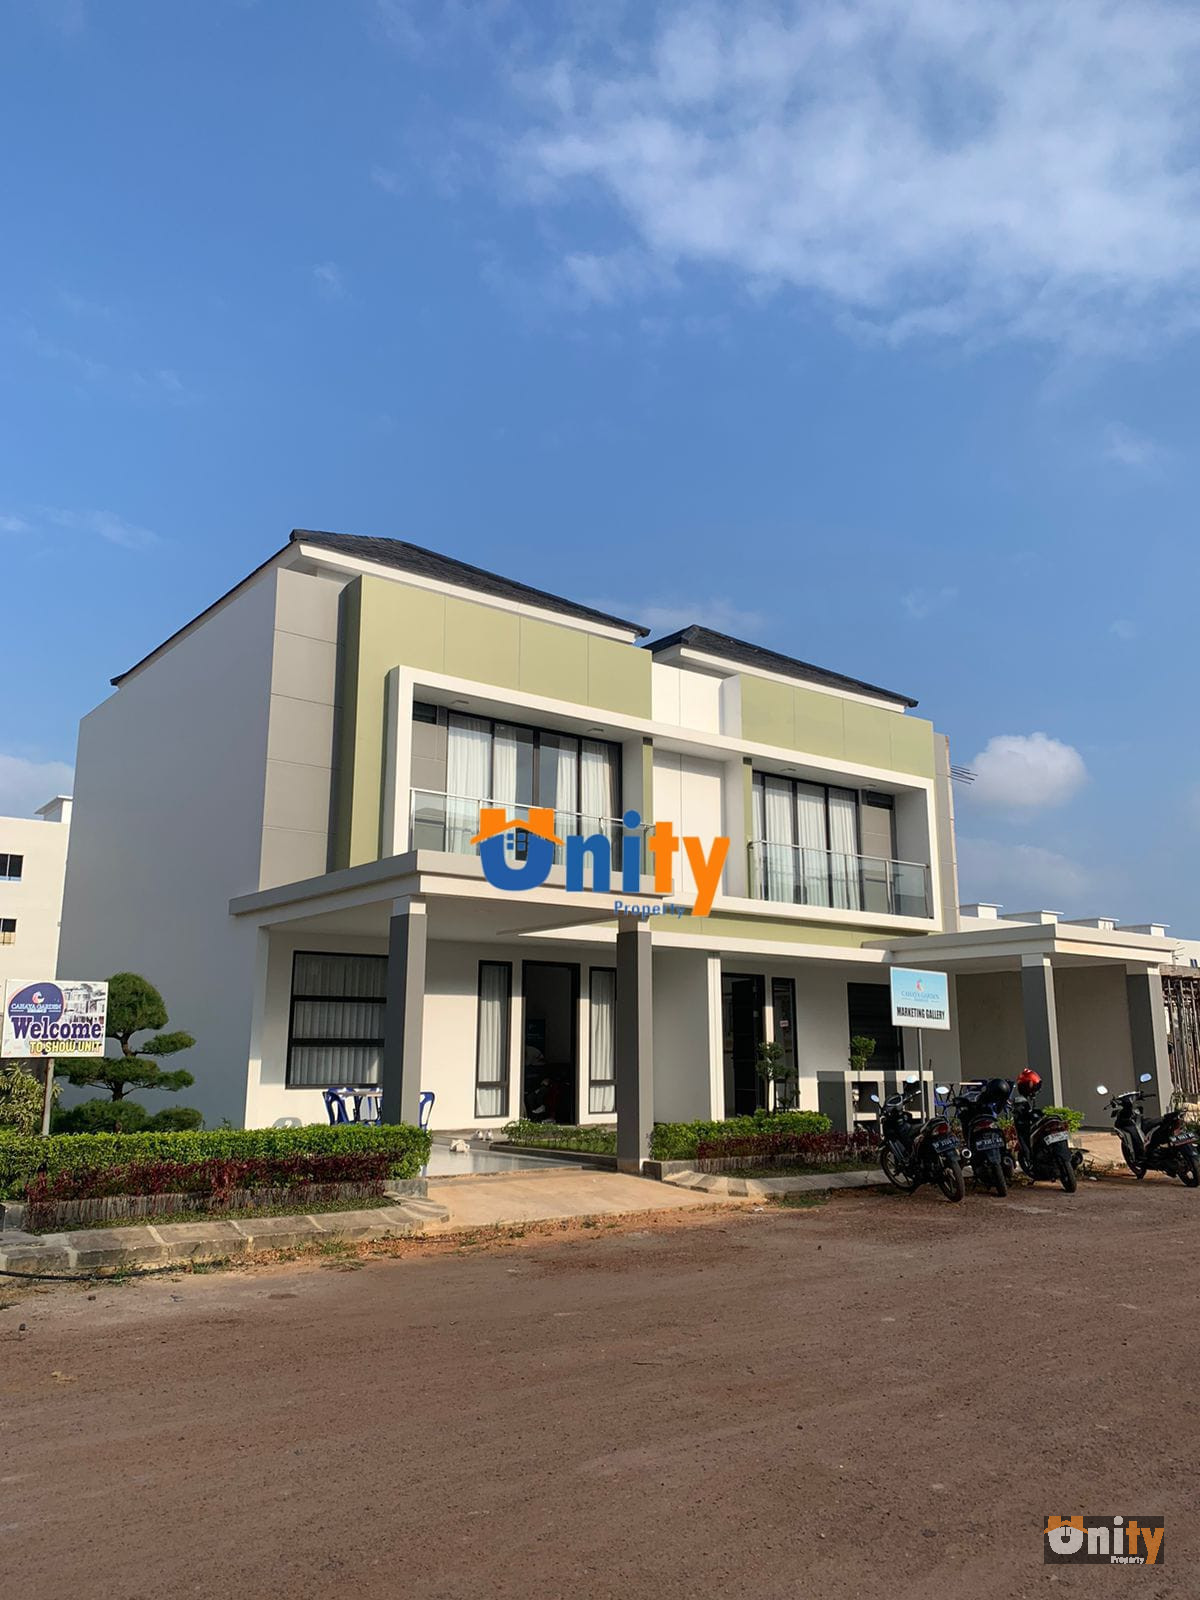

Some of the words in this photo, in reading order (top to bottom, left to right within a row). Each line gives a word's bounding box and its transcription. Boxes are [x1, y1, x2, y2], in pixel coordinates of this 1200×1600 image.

[897, 1007, 925, 1018] MARKETING
[926, 1009, 945, 1020] GALLERY
[11, 1017, 102, 1039] Welcome
[30, 1040, 43, 1053] TO
[44, 1040, 76, 1053] SHOW
[78, 1040, 102, 1053] UNIT
